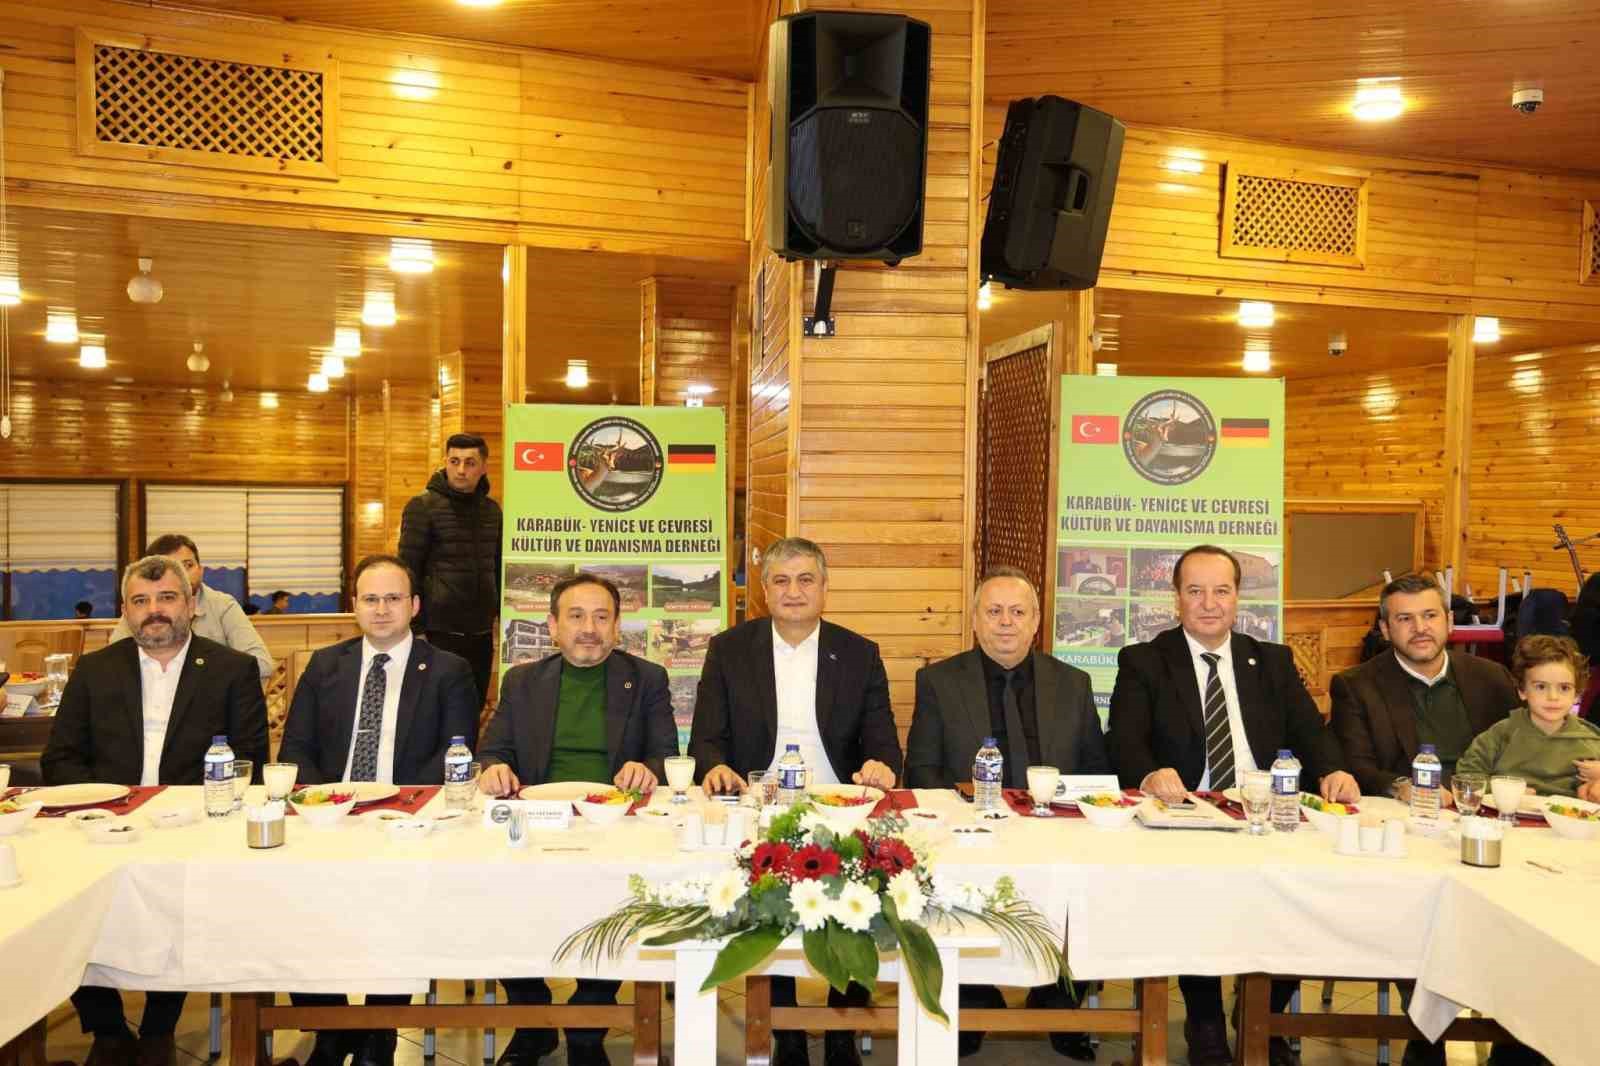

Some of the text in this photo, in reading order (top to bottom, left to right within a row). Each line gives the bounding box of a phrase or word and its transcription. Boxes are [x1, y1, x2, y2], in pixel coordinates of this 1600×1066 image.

[1191, 499, 1208, 513] VE
[590, 517, 636, 533] YENİCE
[639, 519, 655, 533] VE
[1061, 514, 1112, 532] KÜLTÜR
[1115, 517, 1132, 532] VE
[511, 536, 562, 552] KÜLTÜR
[566, 538, 582, 552] VE
